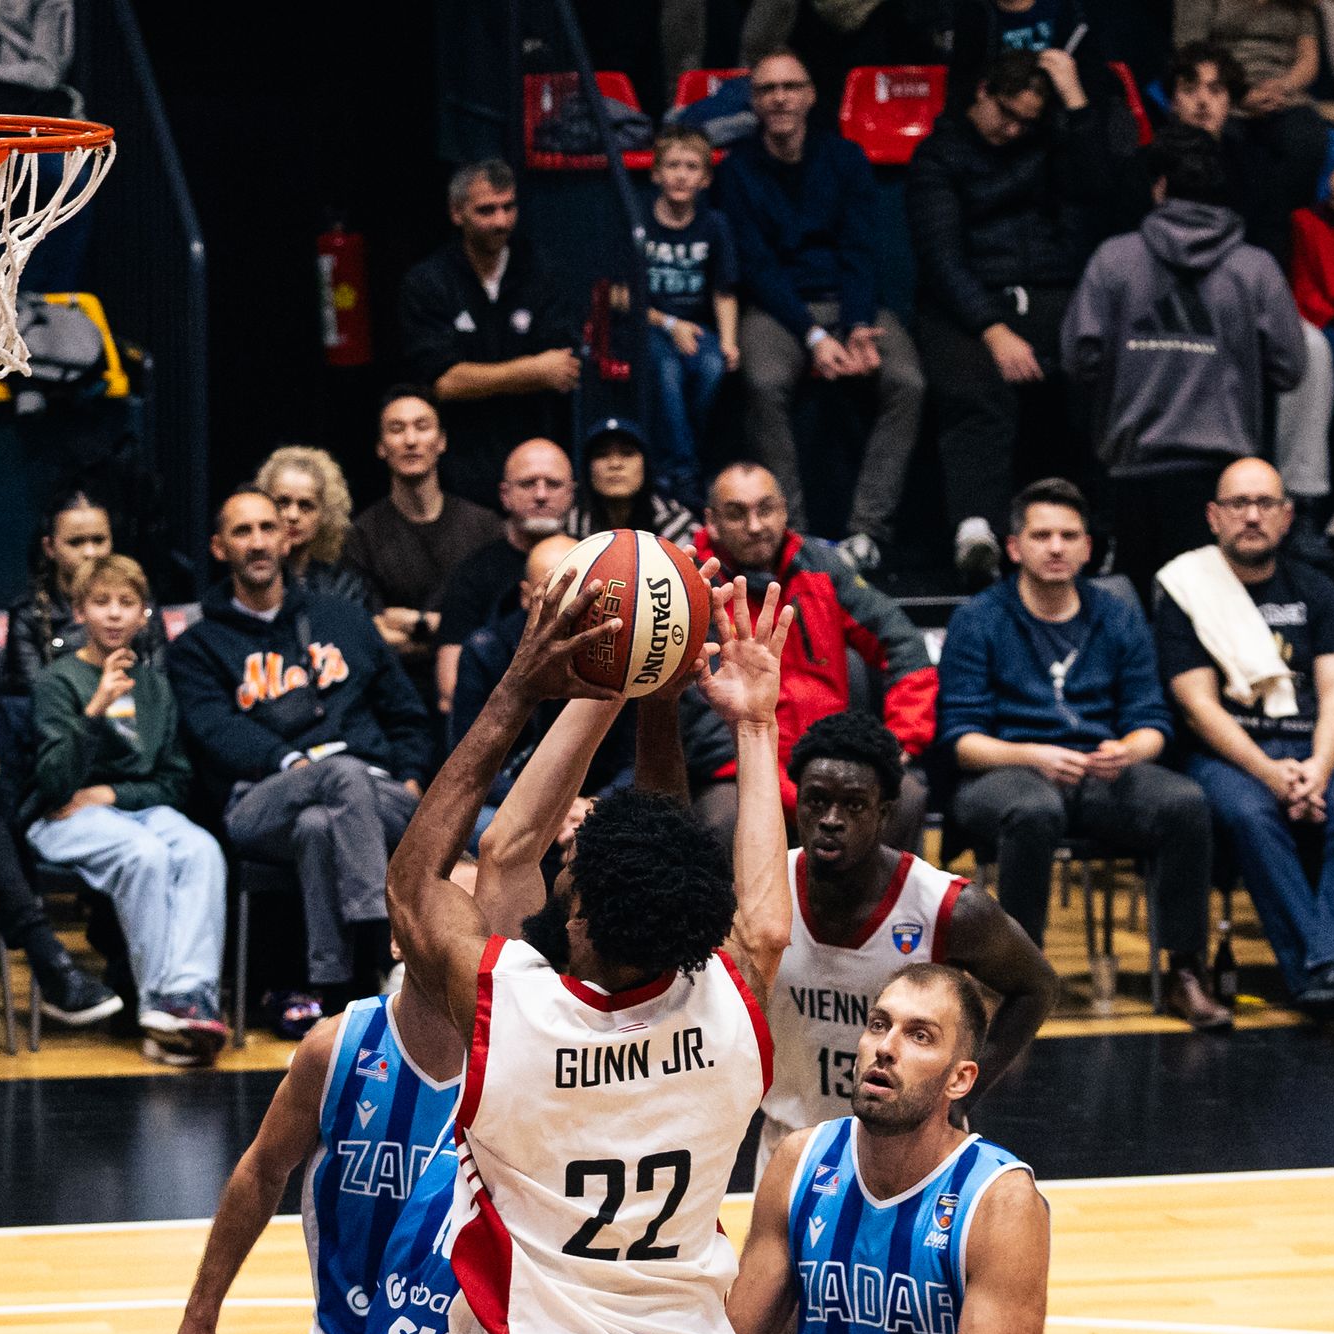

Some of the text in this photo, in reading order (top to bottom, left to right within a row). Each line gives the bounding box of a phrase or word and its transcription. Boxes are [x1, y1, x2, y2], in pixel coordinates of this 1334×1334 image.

[633, 577, 672, 685] SPALDING
[789, 985, 869, 1027] VIENN
[555, 1026, 715, 1089] GUNN JR.
[818, 1047, 858, 1099] 13
[561, 1149, 692, 1262] 22
